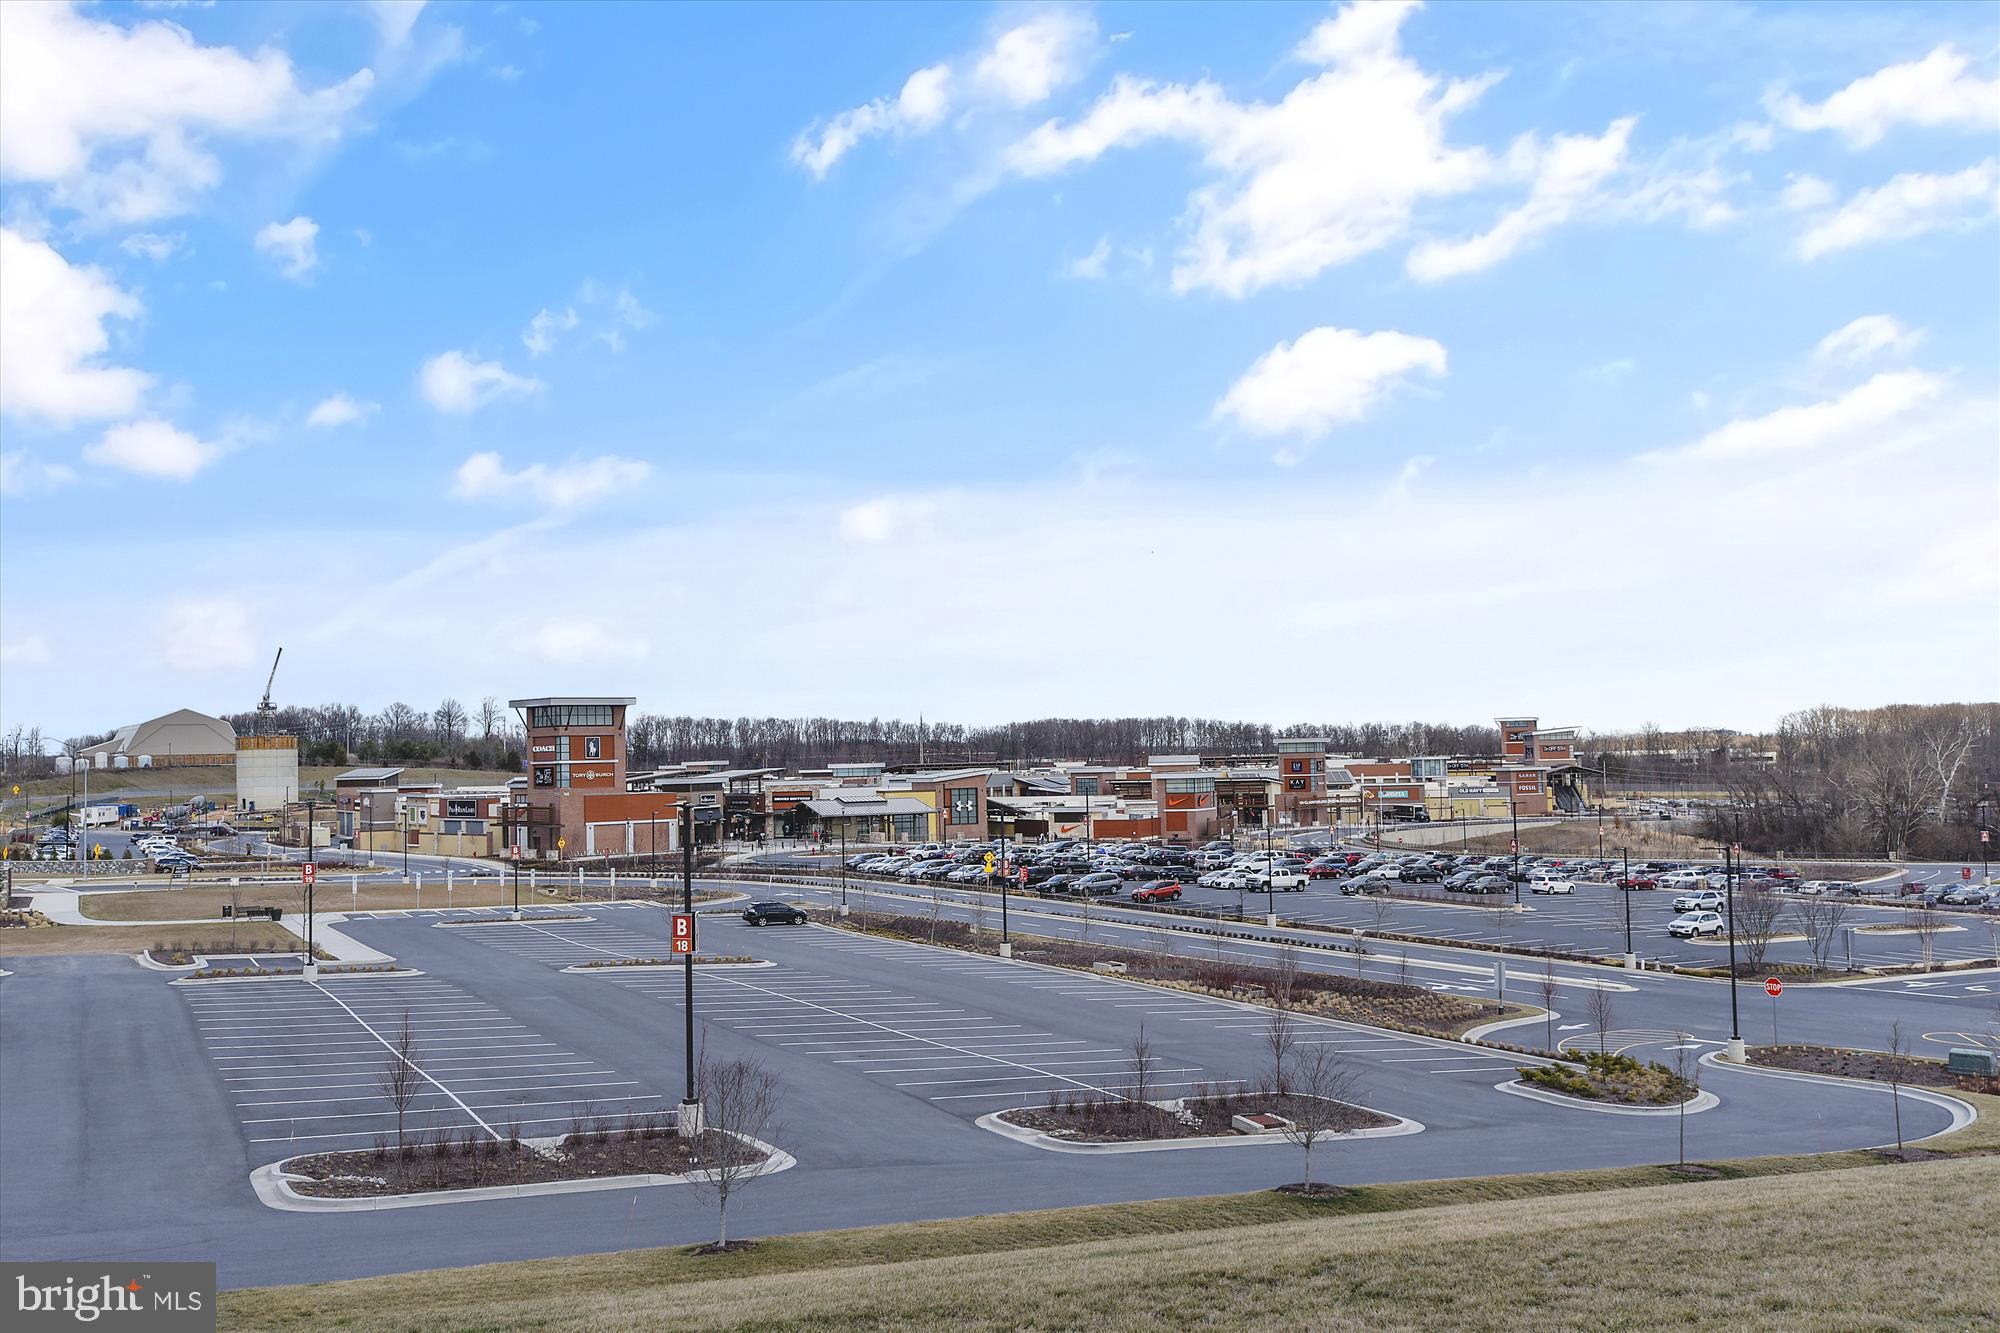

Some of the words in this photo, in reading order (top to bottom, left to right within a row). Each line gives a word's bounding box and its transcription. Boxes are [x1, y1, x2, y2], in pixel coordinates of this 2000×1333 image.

[305, 864, 312, 874] B
[677, 918, 687, 935] B
[676, 940, 688, 951] 18
[1766, 982, 1781, 991] STOP
